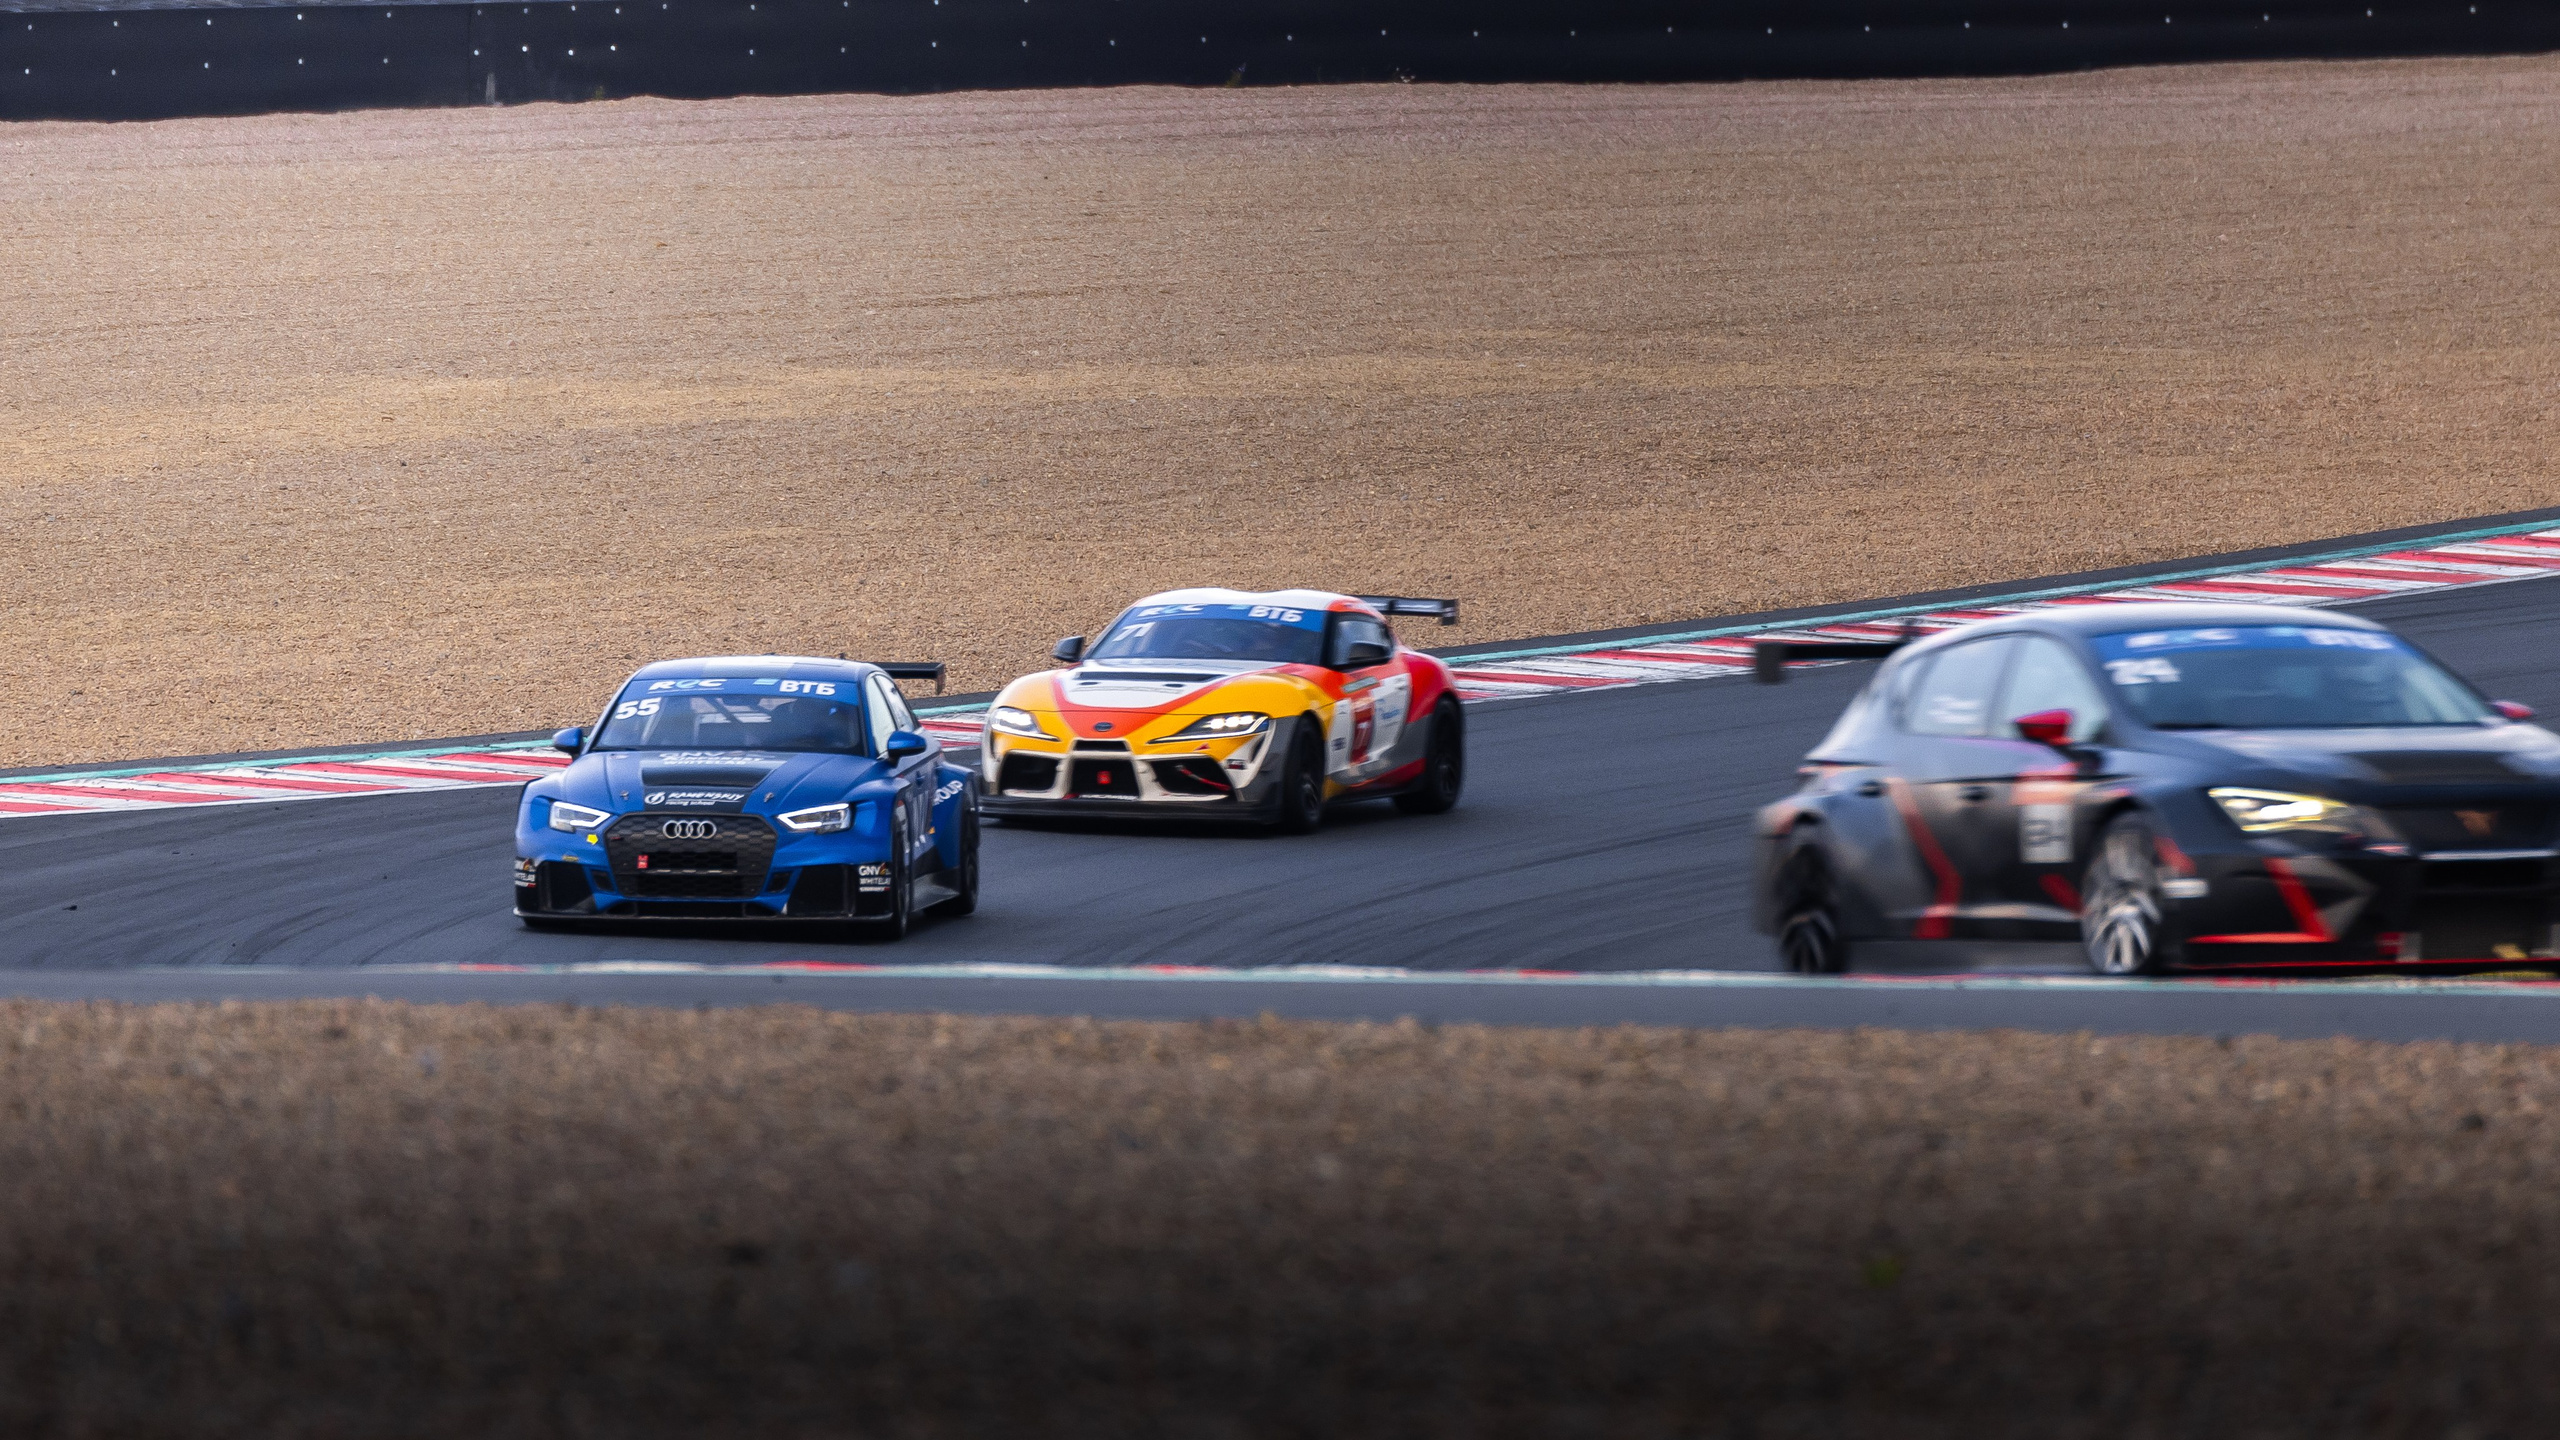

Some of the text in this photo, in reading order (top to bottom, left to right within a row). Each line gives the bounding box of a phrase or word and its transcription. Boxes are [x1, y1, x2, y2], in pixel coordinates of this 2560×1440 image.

[1248, 606, 1303, 623] ВТБ
[1112, 621, 1156, 642] 71
[779, 680, 836, 696] ВТБ
[614, 697, 662, 719] 55
